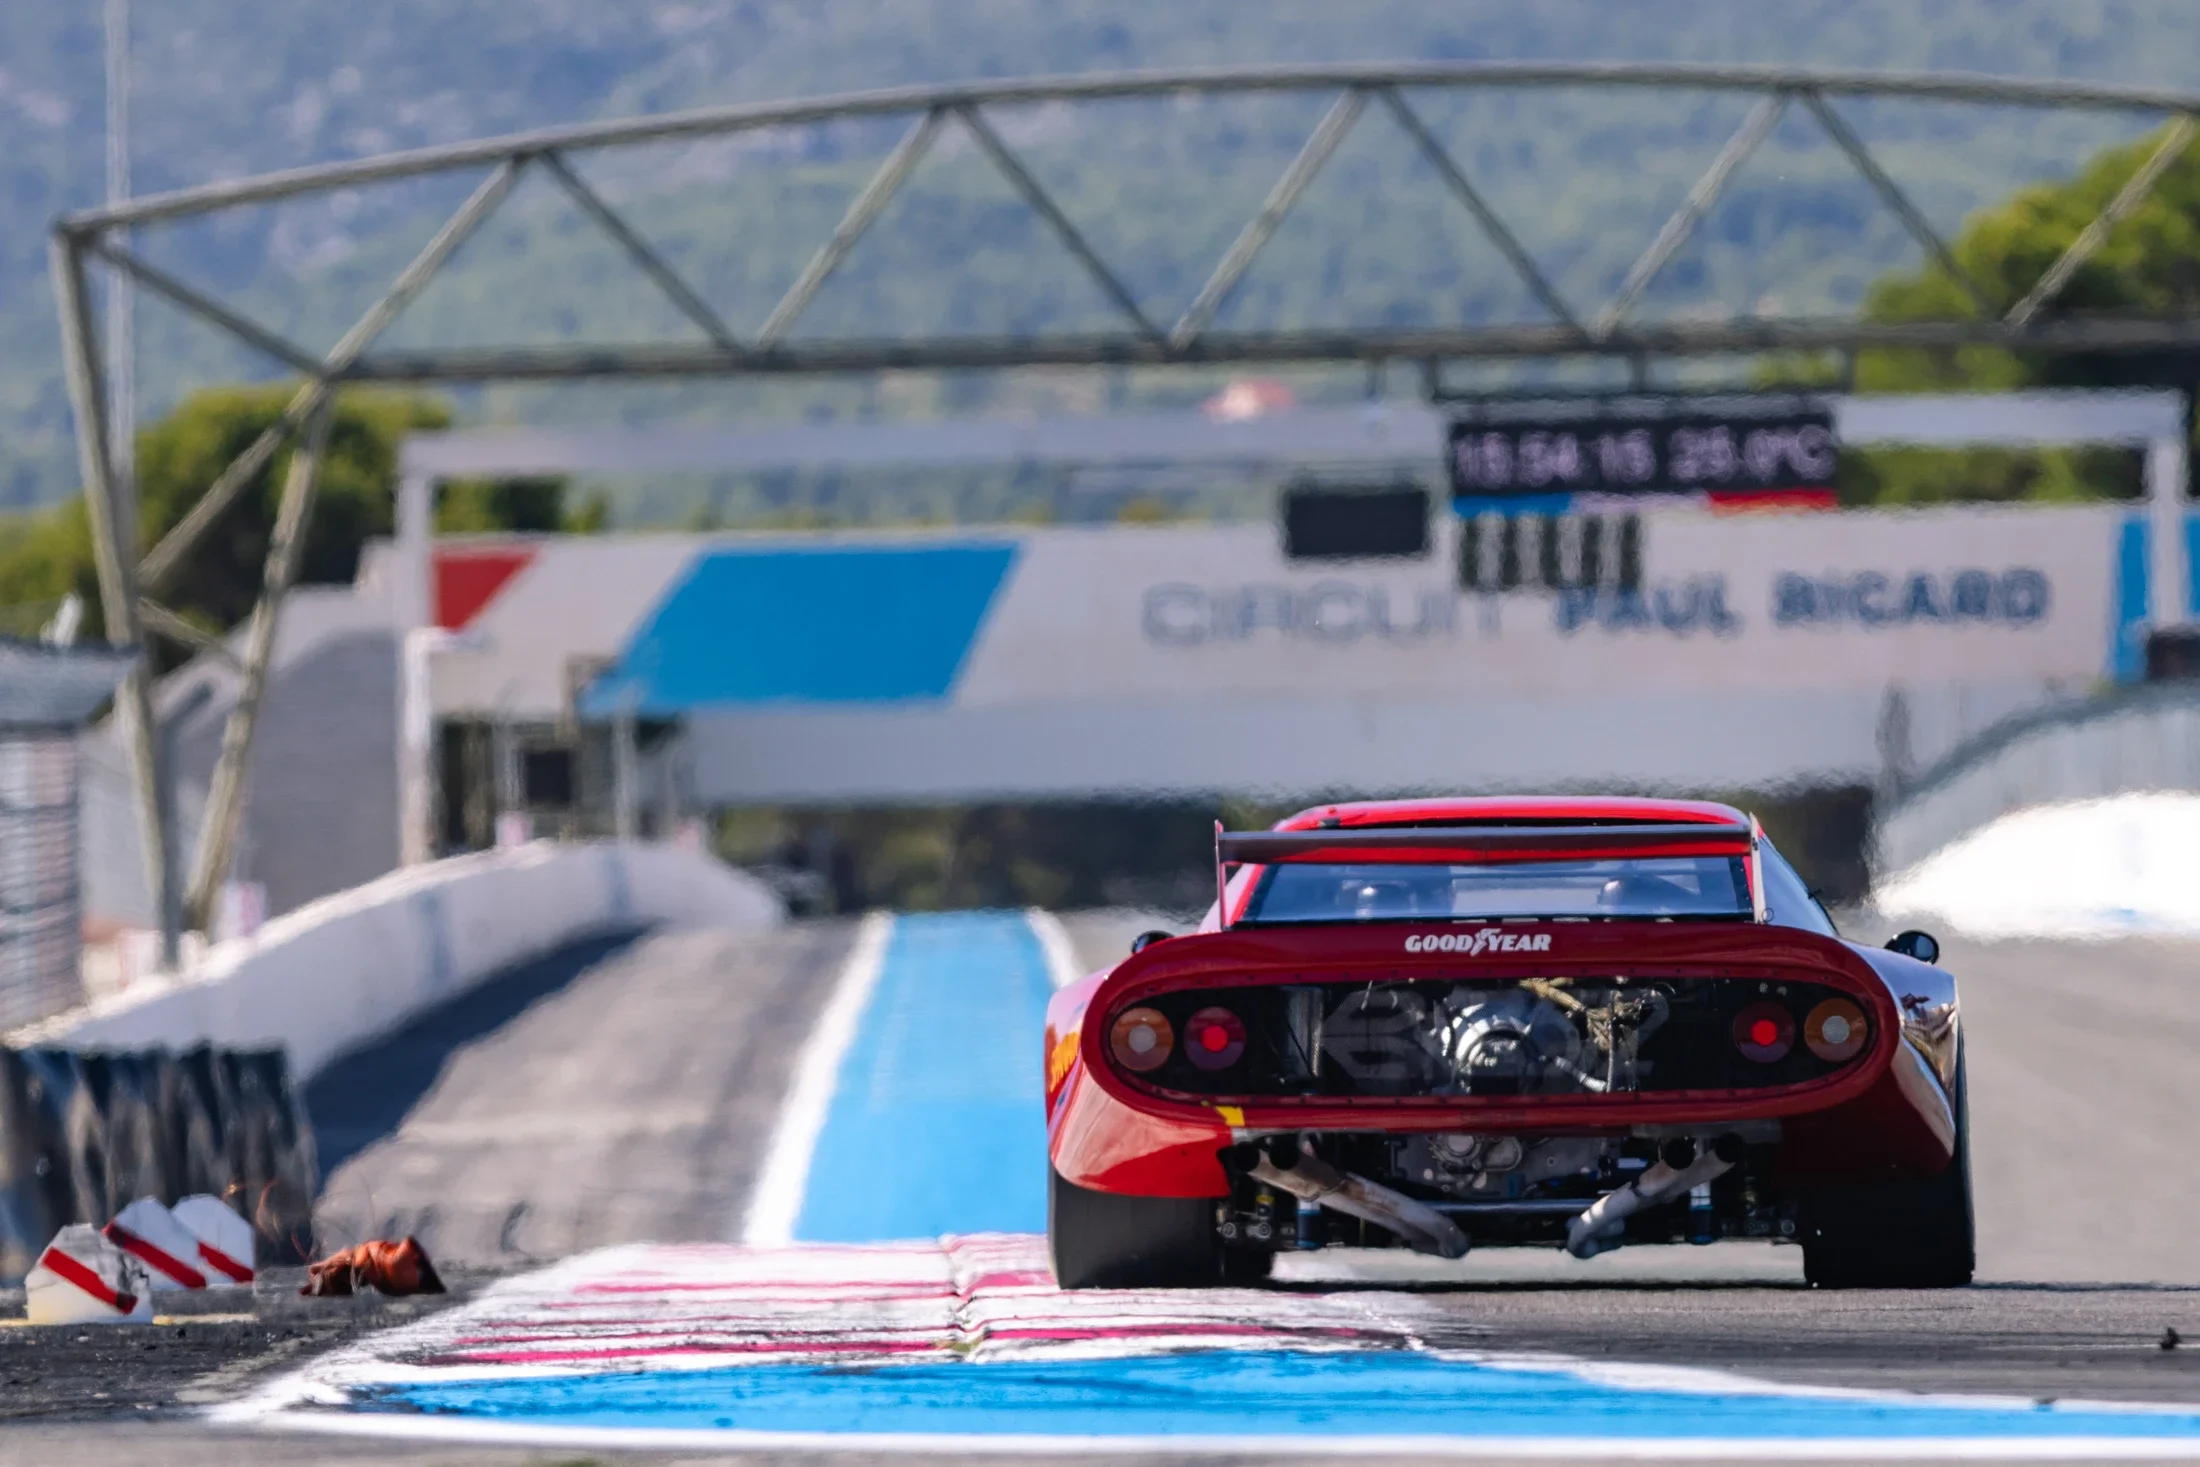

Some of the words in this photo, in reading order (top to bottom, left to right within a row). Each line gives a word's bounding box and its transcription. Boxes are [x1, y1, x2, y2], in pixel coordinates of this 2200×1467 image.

[1141, 580, 1507, 646] CIRCUIT
[1556, 574, 1744, 638] PAUL
[1773, 568, 2050, 631] RICARD
